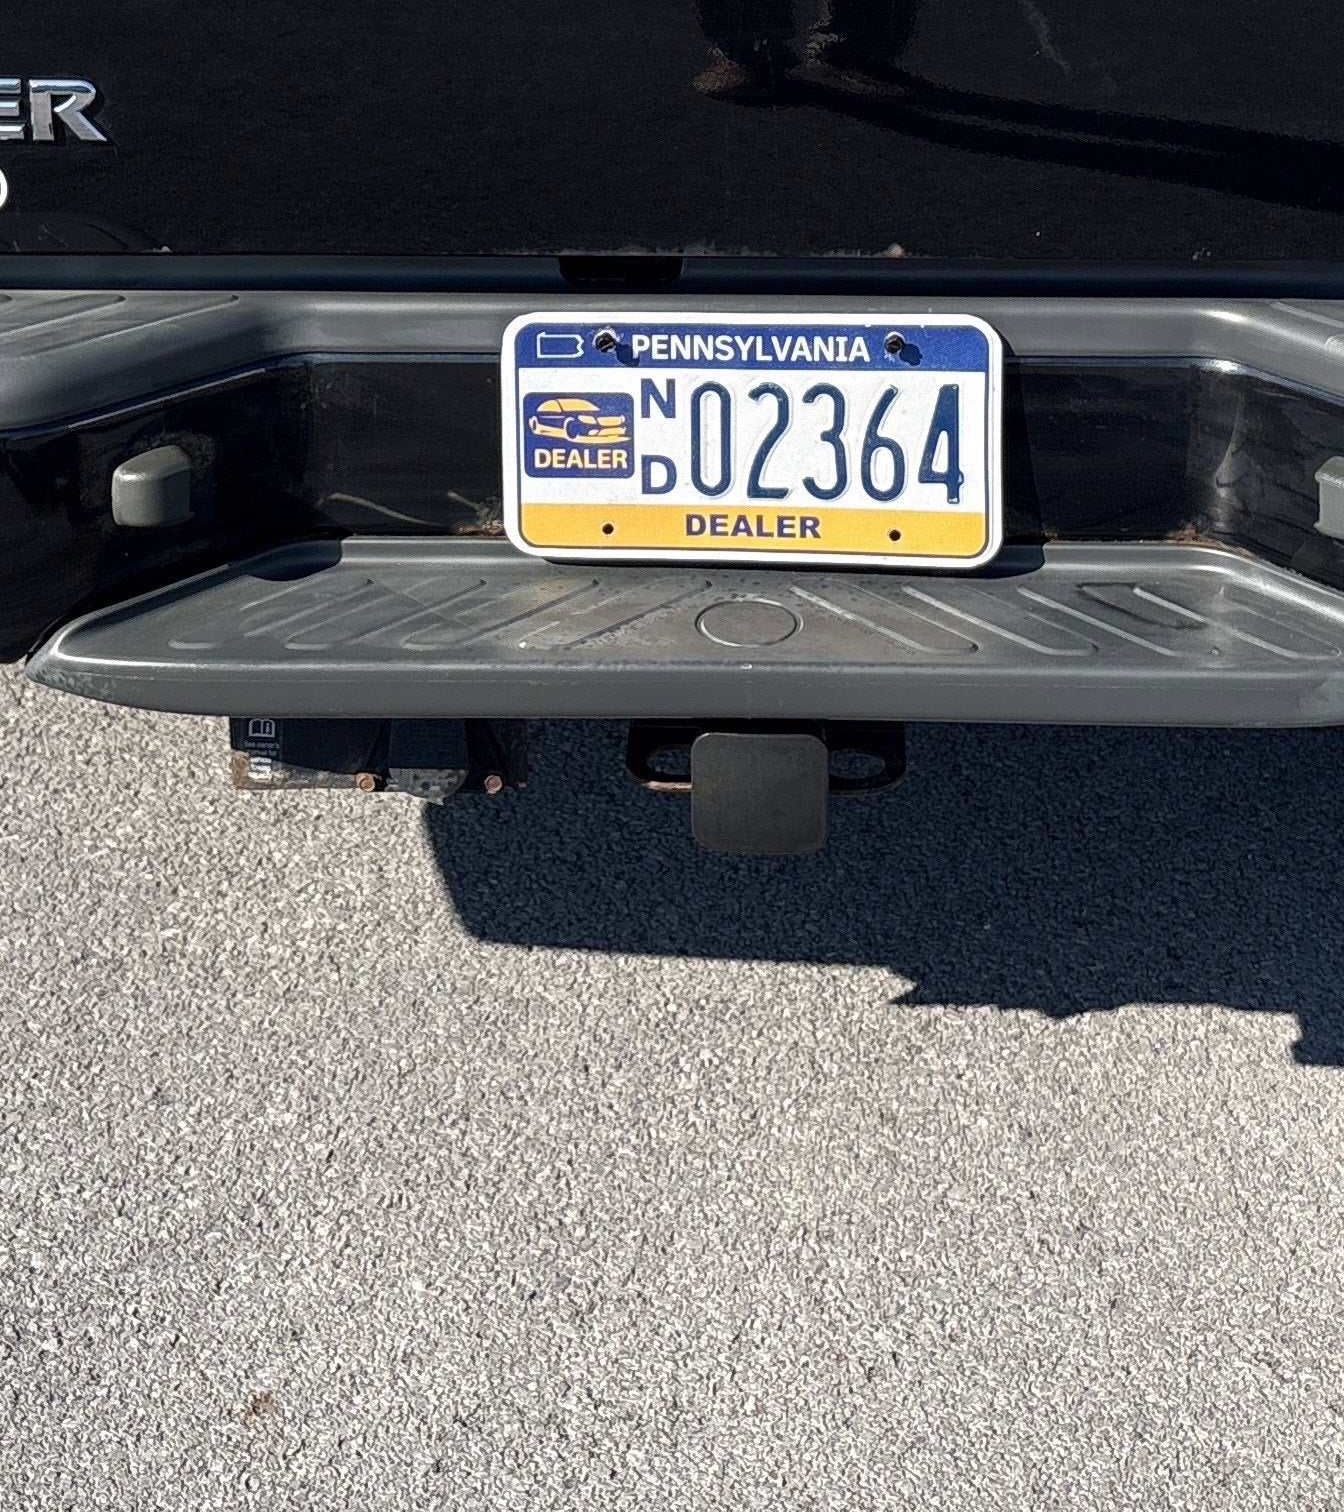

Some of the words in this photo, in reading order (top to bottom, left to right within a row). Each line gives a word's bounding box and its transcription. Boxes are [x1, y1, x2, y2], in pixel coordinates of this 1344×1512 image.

[631, 333, 871, 363] PENNSYLVANIA
[690, 380, 965, 504] 02364
[533, 448, 629, 471] DEALER
[684, 513, 822, 540] DEALER
